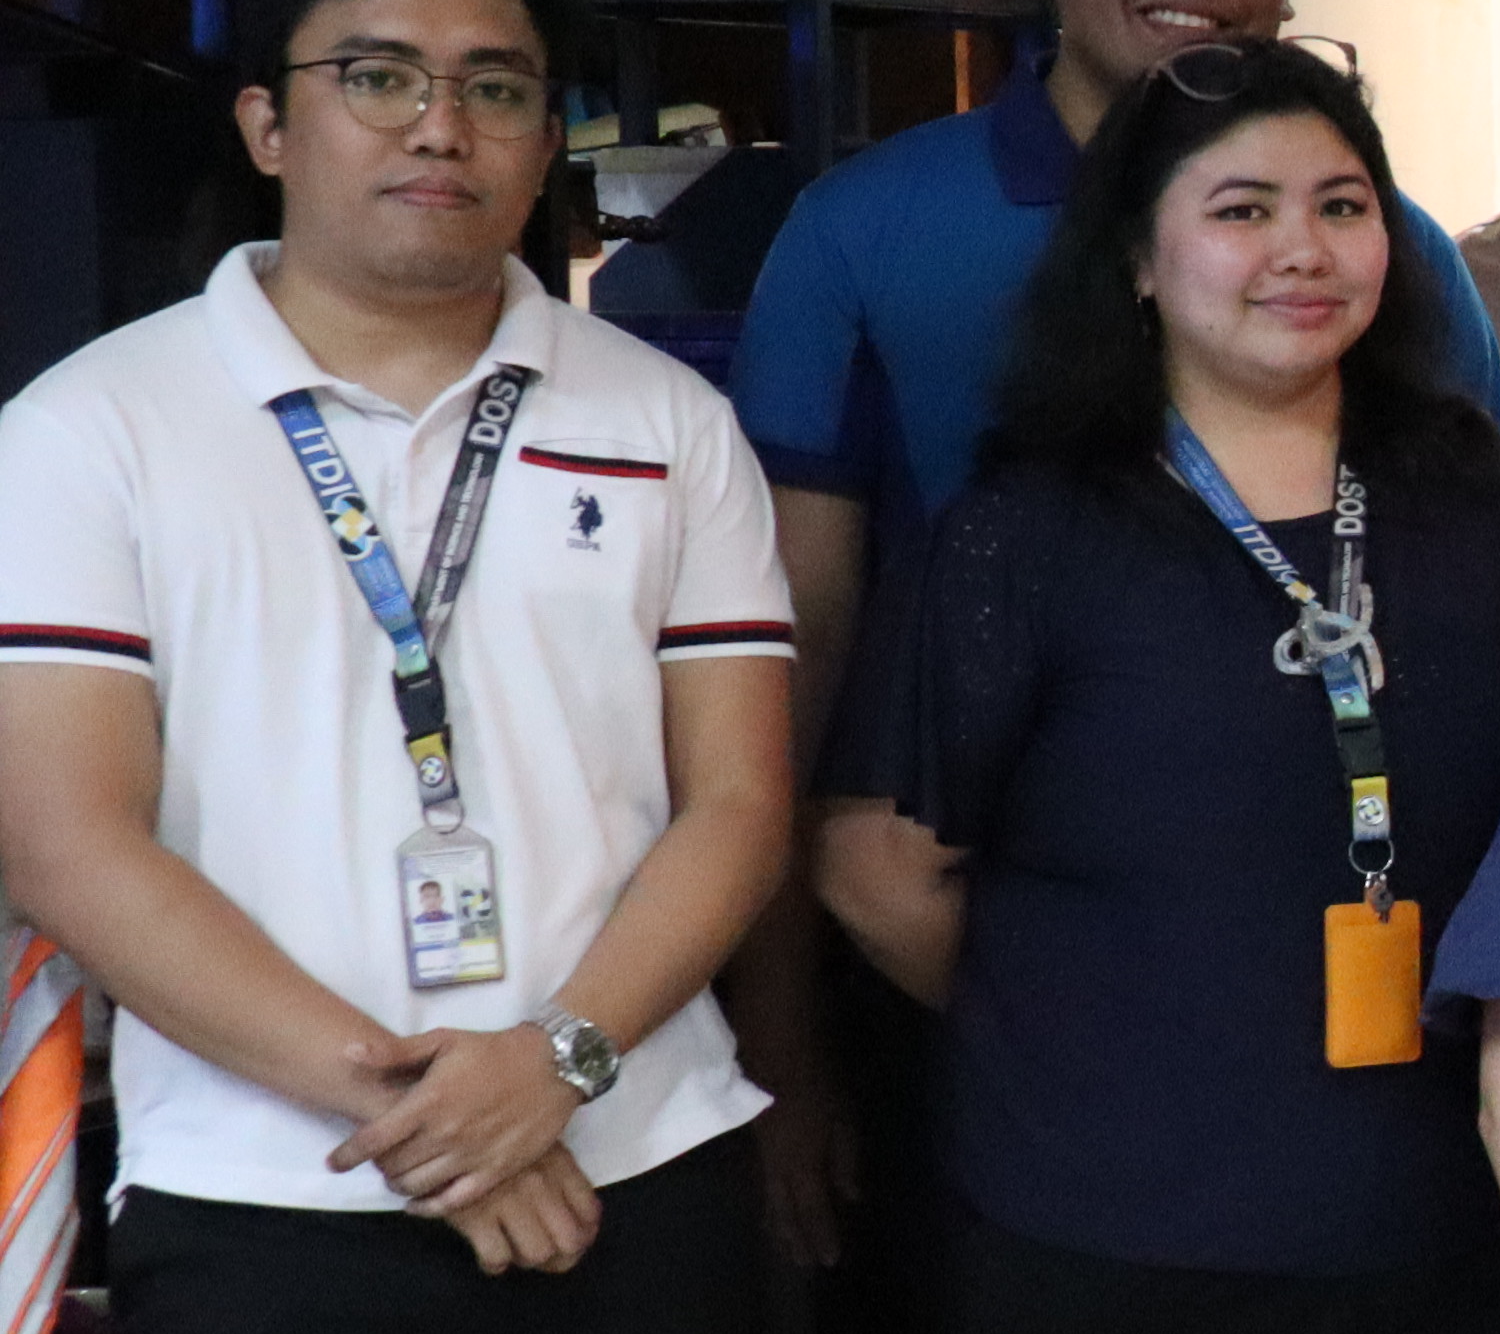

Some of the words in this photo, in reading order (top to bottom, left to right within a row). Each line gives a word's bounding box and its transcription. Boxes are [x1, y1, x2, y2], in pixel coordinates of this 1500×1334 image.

[292, 426, 353, 497] ITDI
[1334, 464, 1366, 536] DOST
[1233, 524, 1293, 571] ITDI
